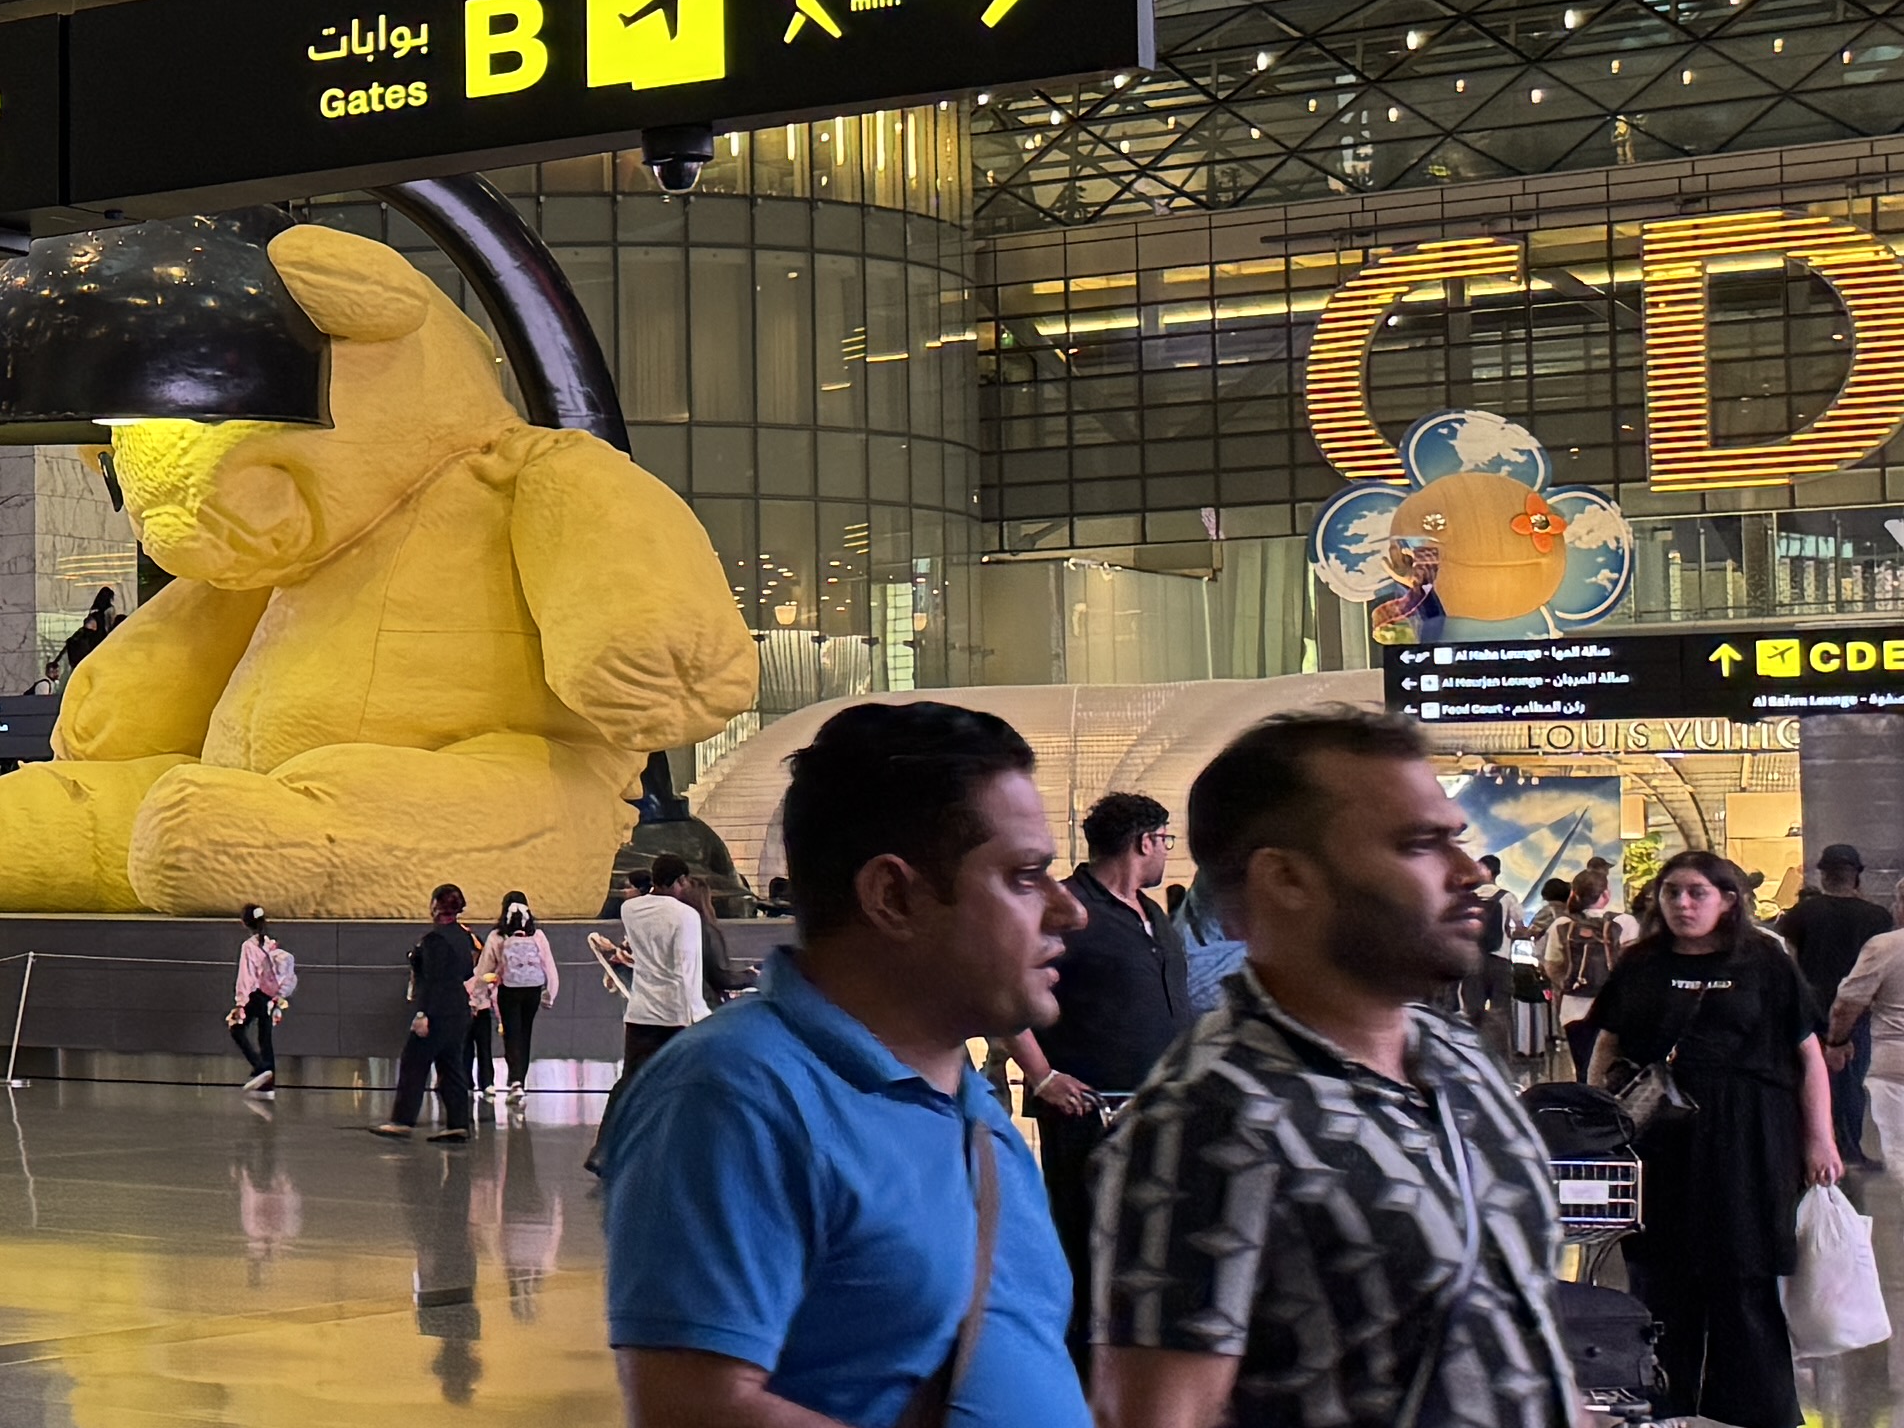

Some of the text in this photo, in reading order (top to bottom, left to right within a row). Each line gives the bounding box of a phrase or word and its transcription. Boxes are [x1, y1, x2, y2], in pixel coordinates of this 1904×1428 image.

[308, 12, 429, 63] بوابات
[320, 80, 428, 119] Gates
[1809, 640, 1904, 673] CDE
[1528, 722, 1649, 749] LOUIS
